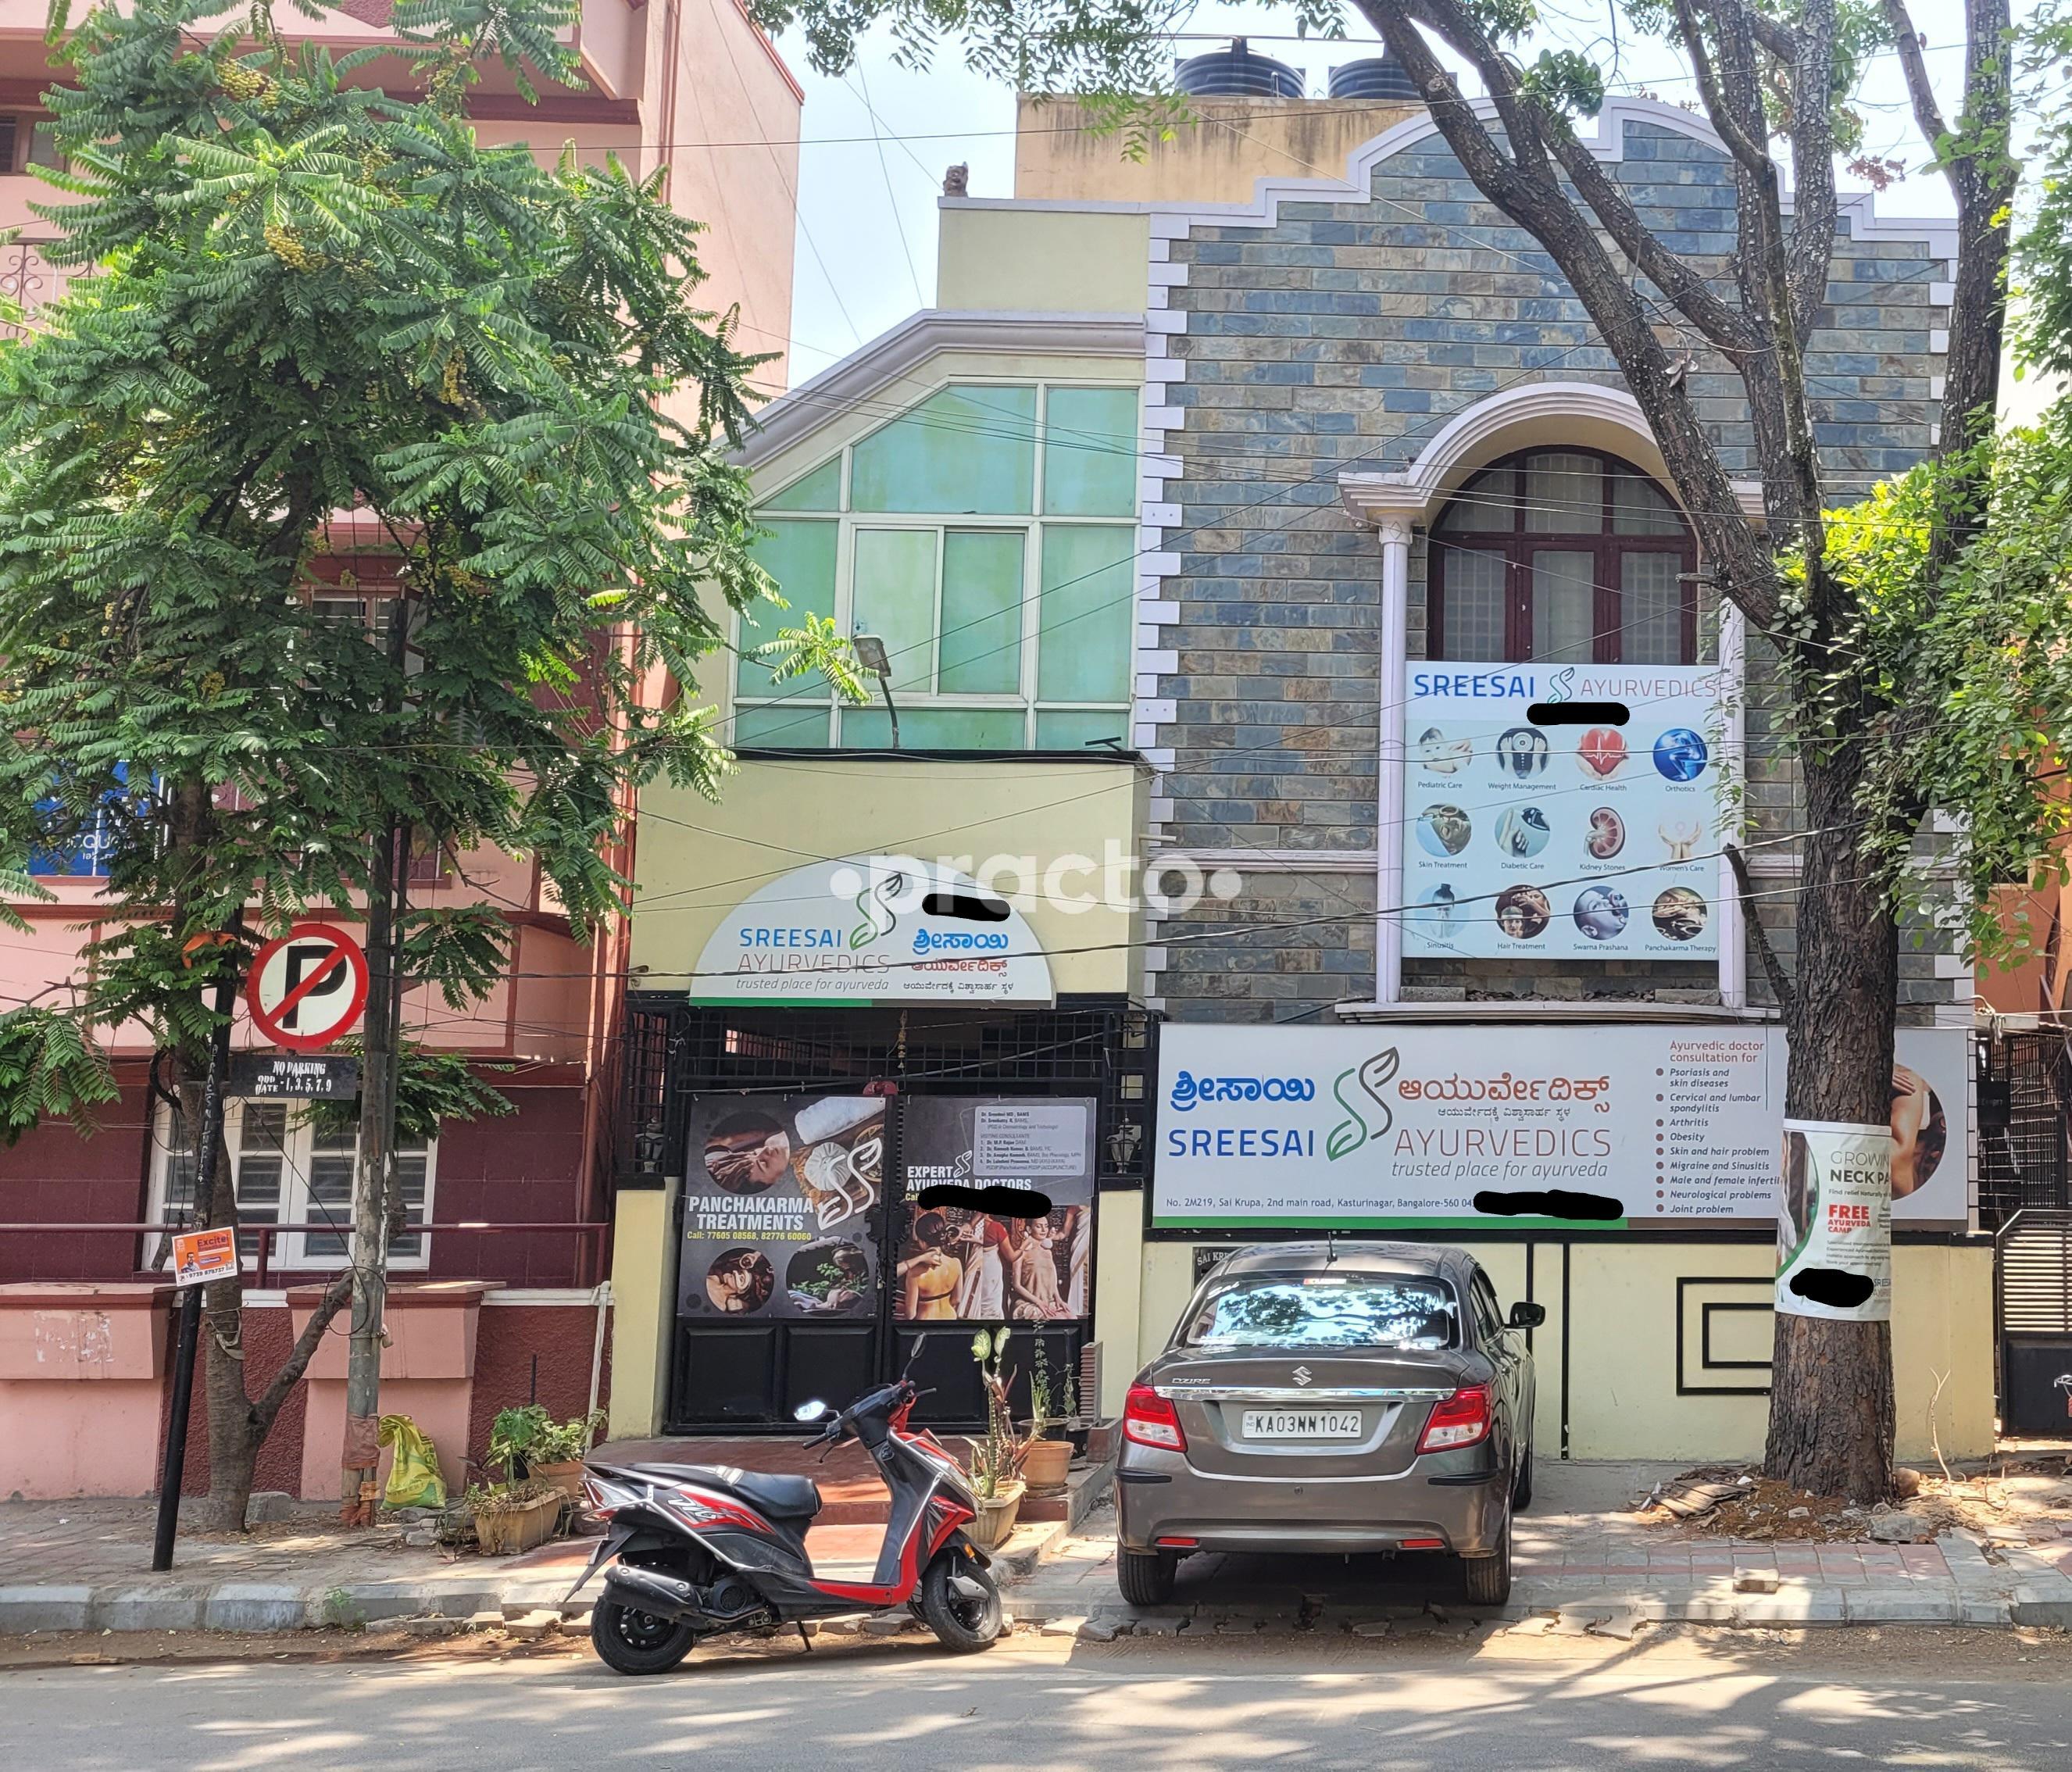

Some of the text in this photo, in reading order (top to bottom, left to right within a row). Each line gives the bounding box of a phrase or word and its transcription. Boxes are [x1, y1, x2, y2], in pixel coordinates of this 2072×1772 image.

[1414, 674, 1717, 698] SREESAI AYURVEDICS
[1488, 782, 1511, 791] Weight
[740, 928, 841, 948] SREESAI
[738, 953, 890, 974] AYURVEDICS
[736, 978, 889, 992] trusted place for ayurveda
[1670, 1040, 1765, 1052] Ayurvedic doctor
[1670, 1052, 1758, 1063] consultation for
[273, 1061, 327, 1078] NO PARKING
[1670, 1068, 1730, 1077] Psoriasis and
[1670, 1079, 1729, 1088] skin diseases
[255, 1084, 278, 1095] DATE
[1170, 1071, 1315, 1112] ಶ್ರೀಸಾಯಿ
[1670, 1093, 1761, 1102] Cervical and lumbar
[1670, 1104, 1720, 1114] spondylitis
[1169, 1129, 1611, 1156] SREESAI AYURVEDICS
[1670, 1132, 1706, 1142] Obesity
[1670, 1146, 1770, 1157] Skin and hair problem
[1391, 1161, 1608, 1181] trusted place for ayurveda
[1670, 1161, 1770, 1171] Migraine and Sinusitis
[907, 1166, 953, 1178] EXPERT
[1830, 1169, 1875, 1184] NECK
[975, 1179, 1032, 1191] DOCTORS
[1670, 1175, 1781, 1186] Male and female infertil
[1670, 1190, 1771, 1201] Neurological problems
[689, 1195, 813, 1213] PANCHAKARMA
[1166, 1199, 1474, 1209] No. 2M219, Sai Krupa, 2nd main road, Kasturinagar, Bangalore-560 04
[1670, 1204, 1734, 1215] Joint problem
[1829, 1204, 1870, 1220] FREE
[696, 1213, 804, 1231] TREATMENTS
[1827, 1219, 1871, 1227] AYURVEDA
[687, 1231, 705, 1240] Call:
[707, 1231, 731, 1240] 77605
[1197, 1252, 1211, 1266] SAI
